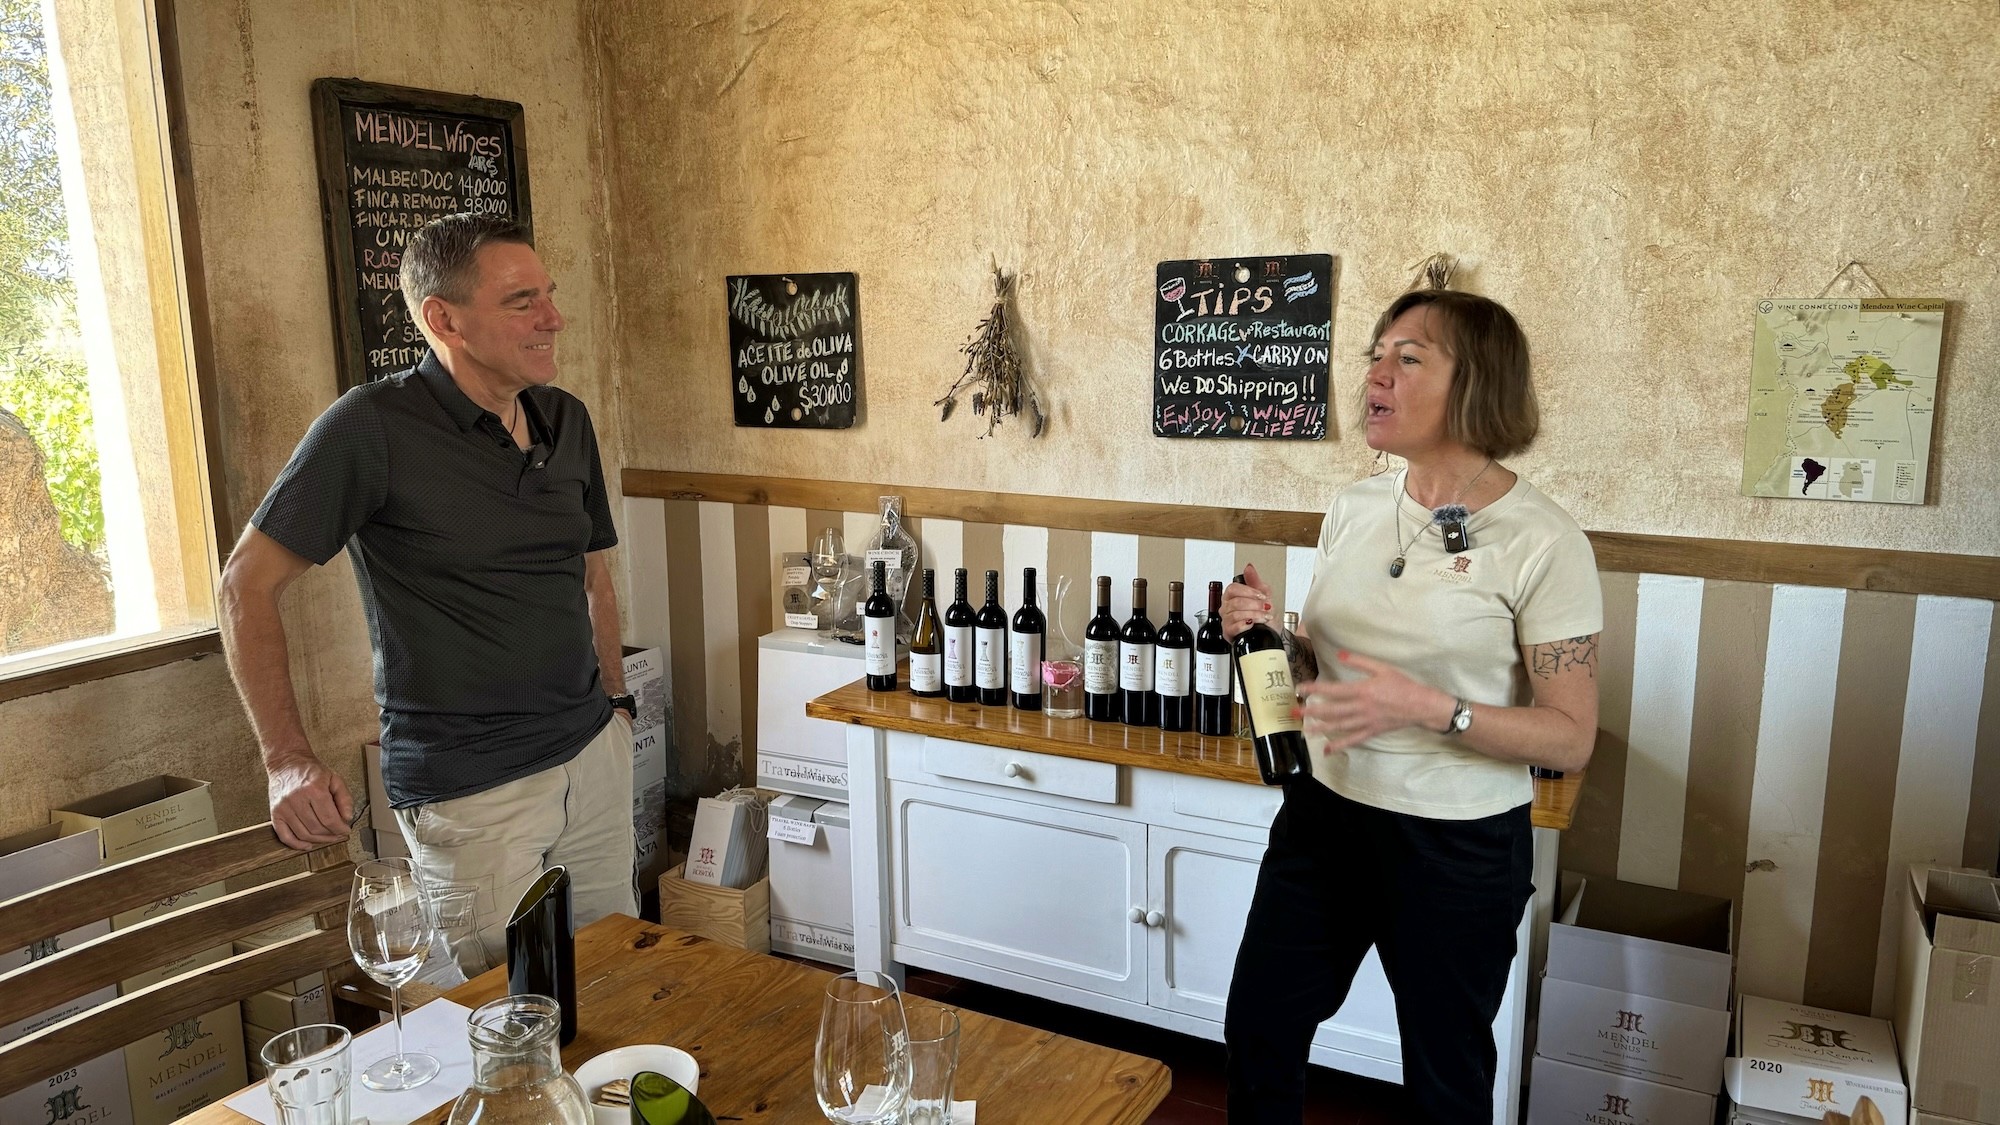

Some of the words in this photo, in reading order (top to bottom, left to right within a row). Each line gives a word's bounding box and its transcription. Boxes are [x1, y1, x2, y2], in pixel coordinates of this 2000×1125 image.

[355, 111, 443, 151] MENDEL
[443, 121, 501, 157] Wines
[353, 165, 418, 188] MALBEC
[420, 169, 454, 191] DOC
[458, 175, 507, 197] 140000
[354, 188, 399, 209] FINCA
[402, 192, 458, 212] REMOTA
[464, 197, 507, 215] 98000
[356, 211, 398, 229] FINCA
[1917, 302, 1944, 312] Capital
[1162, 322, 1240, 344] CORKAGE
[1252, 320, 1331, 341] Restaurant
[369, 348, 411, 368] PETIT
[738, 341, 794, 368] ACEITE
[796, 341, 812, 359] de
[812, 332, 852, 357] OLIVA
[1159, 348, 1173, 370] 6
[1174, 348, 1235, 369] Bottles
[1253, 344, 1302, 367] CARRY
[1304, 347, 1329, 364] ON
[761, 362, 807, 385] OLIVE
[810, 362, 836, 379] OIL
[799, 381, 851, 416] $30000
[1161, 375, 1191, 395] We
[1193, 376, 1215, 394] DO
[1217, 373, 1298, 404] Shipping
[1163, 401, 1226, 430] ENJOY
[135, 804, 184, 826] MENDEL
[303, 987, 325, 1004] 2021
[1597, 1029, 1660, 1050] MENDEL
[1613, 1042, 1641, 1053] UNUS
[149, 1043, 228, 1088] MENDEL
[1750, 1059, 1783, 1074] 2020
[48, 1068, 78, 1088] 2023
[156, 1087, 177, 1100] MALBEC
[66, 1106, 112, 1125] DEL
